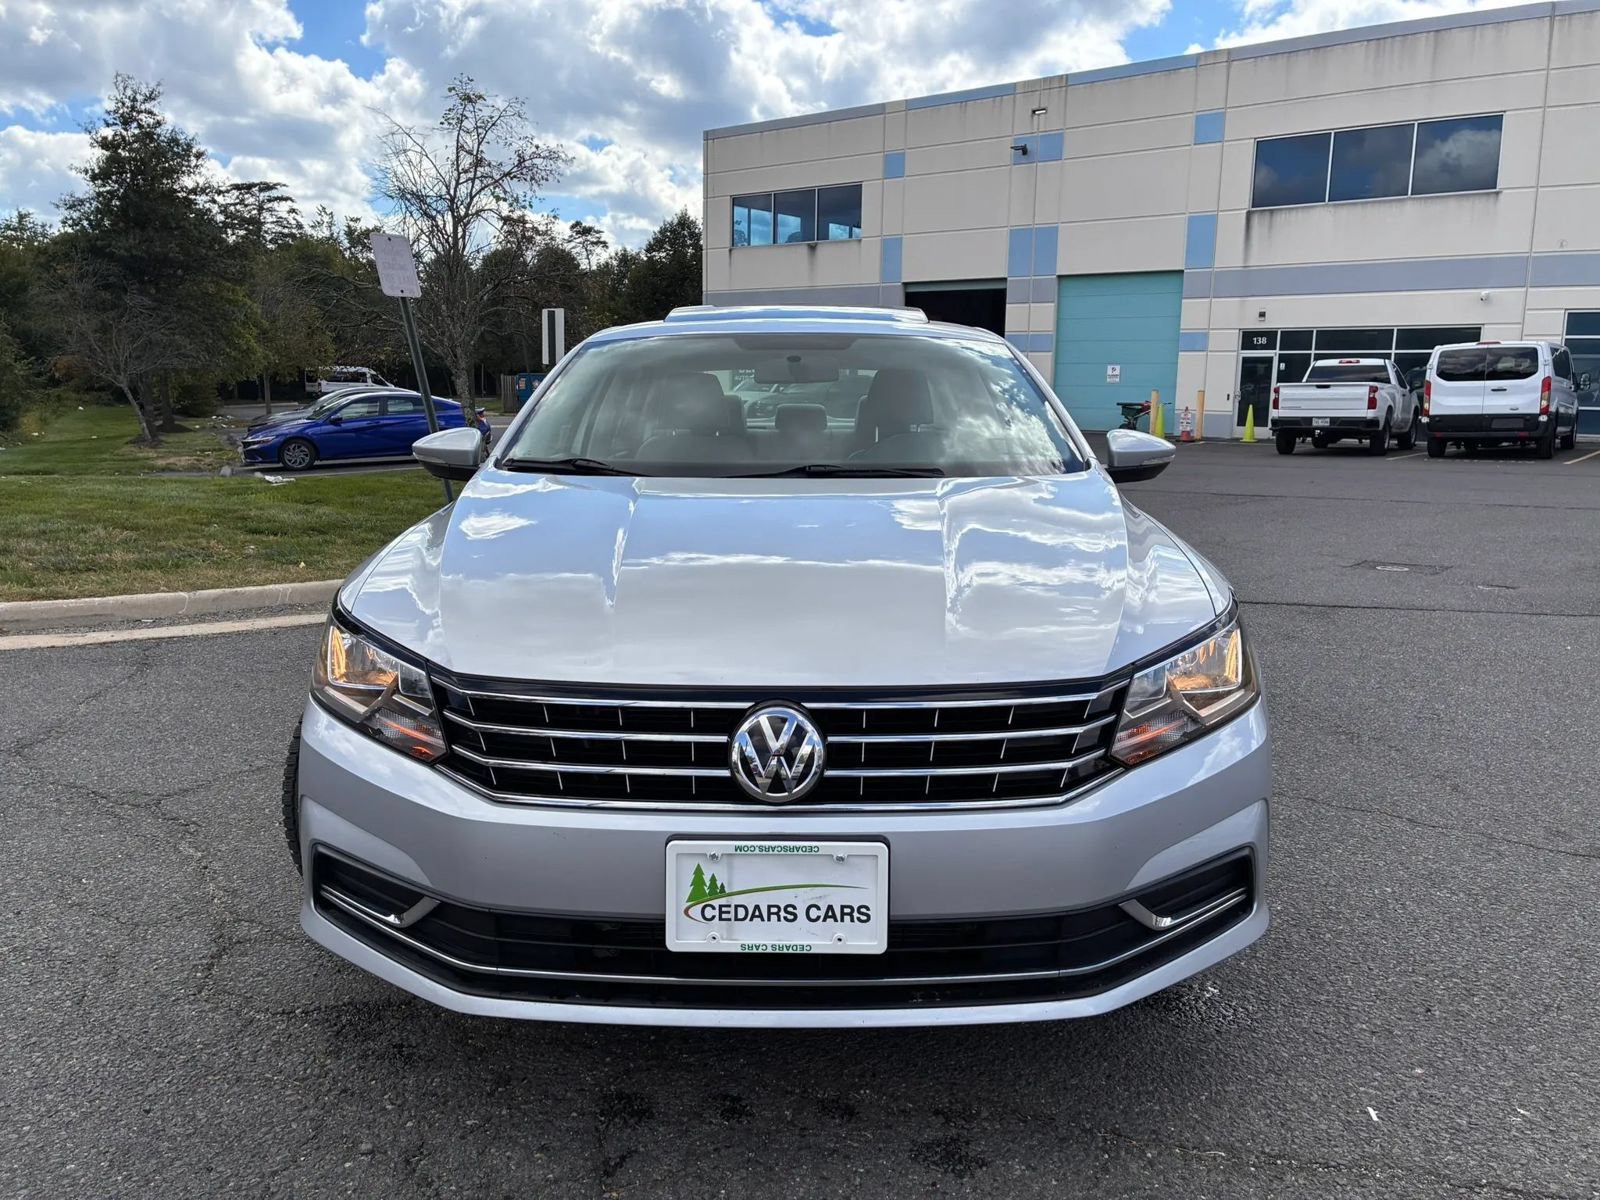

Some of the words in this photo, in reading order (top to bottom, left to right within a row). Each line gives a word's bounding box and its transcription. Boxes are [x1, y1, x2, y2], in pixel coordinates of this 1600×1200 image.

[1252, 336, 1267, 345] 138
[734, 709, 821, 799] VW
[734, 844, 820, 853] CEDARSCARS.COM
[700, 903, 798, 923] CEDARS
[805, 903, 872, 924] CARS
[740, 943, 768, 952] CARS
[770, 943, 812, 952] CEDARS
